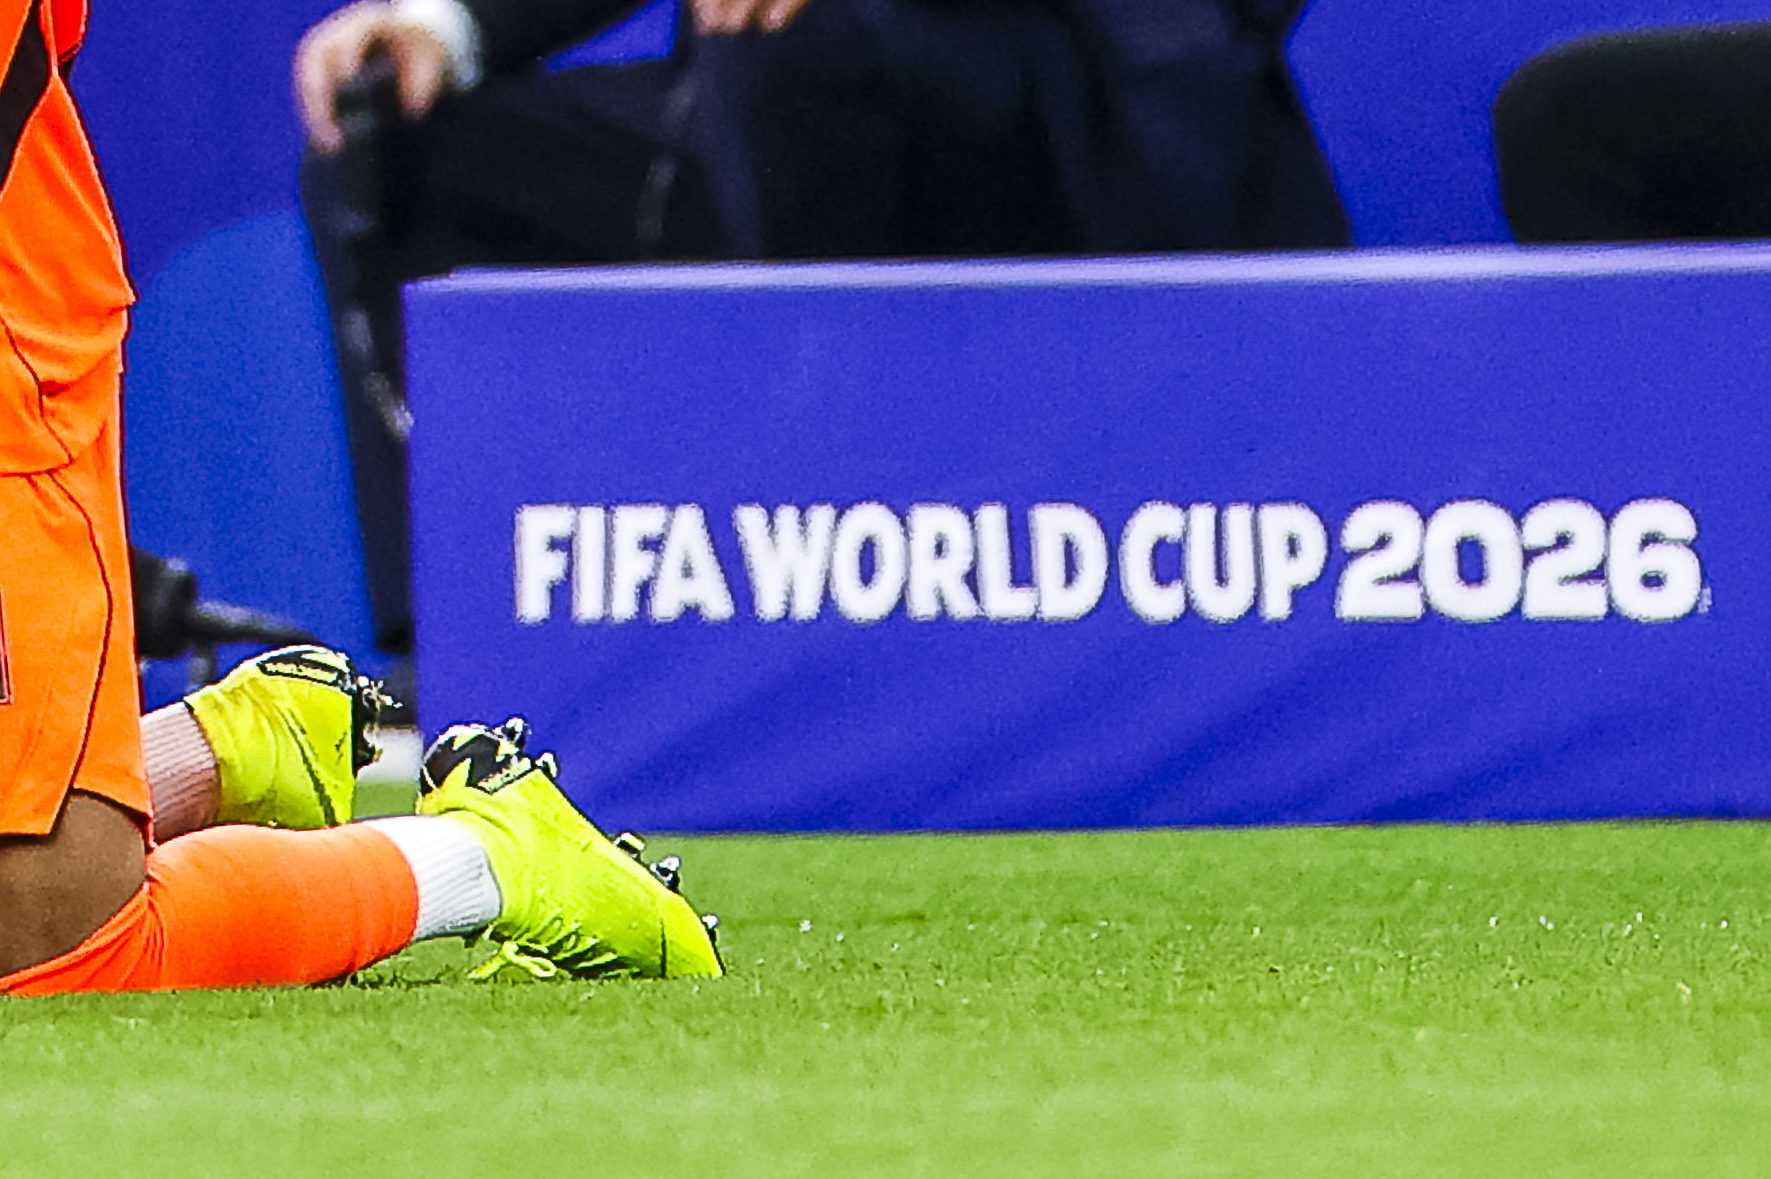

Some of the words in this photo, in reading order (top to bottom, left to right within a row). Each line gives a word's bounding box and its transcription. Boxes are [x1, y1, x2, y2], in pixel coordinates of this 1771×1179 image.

[515, 502, 734, 624] FIFA
[733, 501, 1109, 624] WORLD
[1118, 500, 1328, 624] CUP
[1335, 498, 1703, 624] 2026
